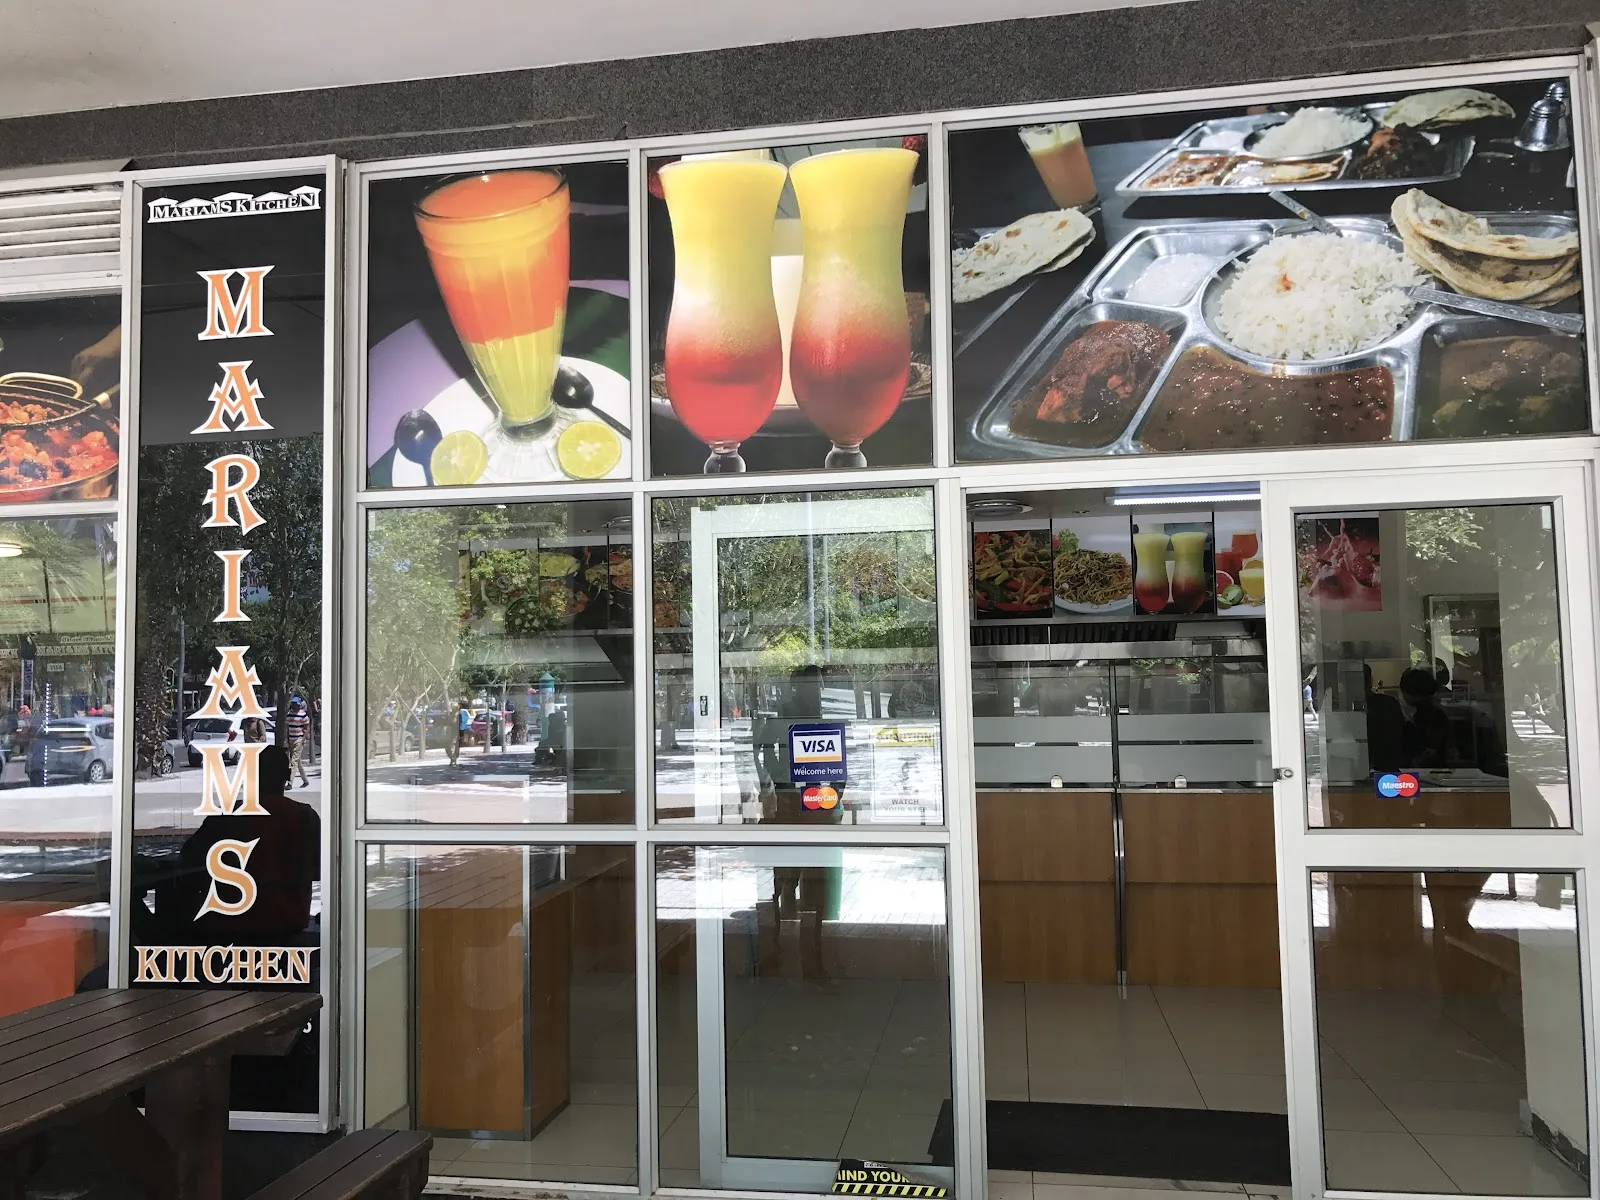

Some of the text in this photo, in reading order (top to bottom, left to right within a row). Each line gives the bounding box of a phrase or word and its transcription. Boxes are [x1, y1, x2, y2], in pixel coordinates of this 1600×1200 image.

[189, 265, 275, 922] MARIAMS
[799, 740, 836, 753] VISA
[794, 766, 843, 776] Welcome here
[1382, 781, 1415, 789] Maestro
[133, 943, 320, 984] KITCHEN
